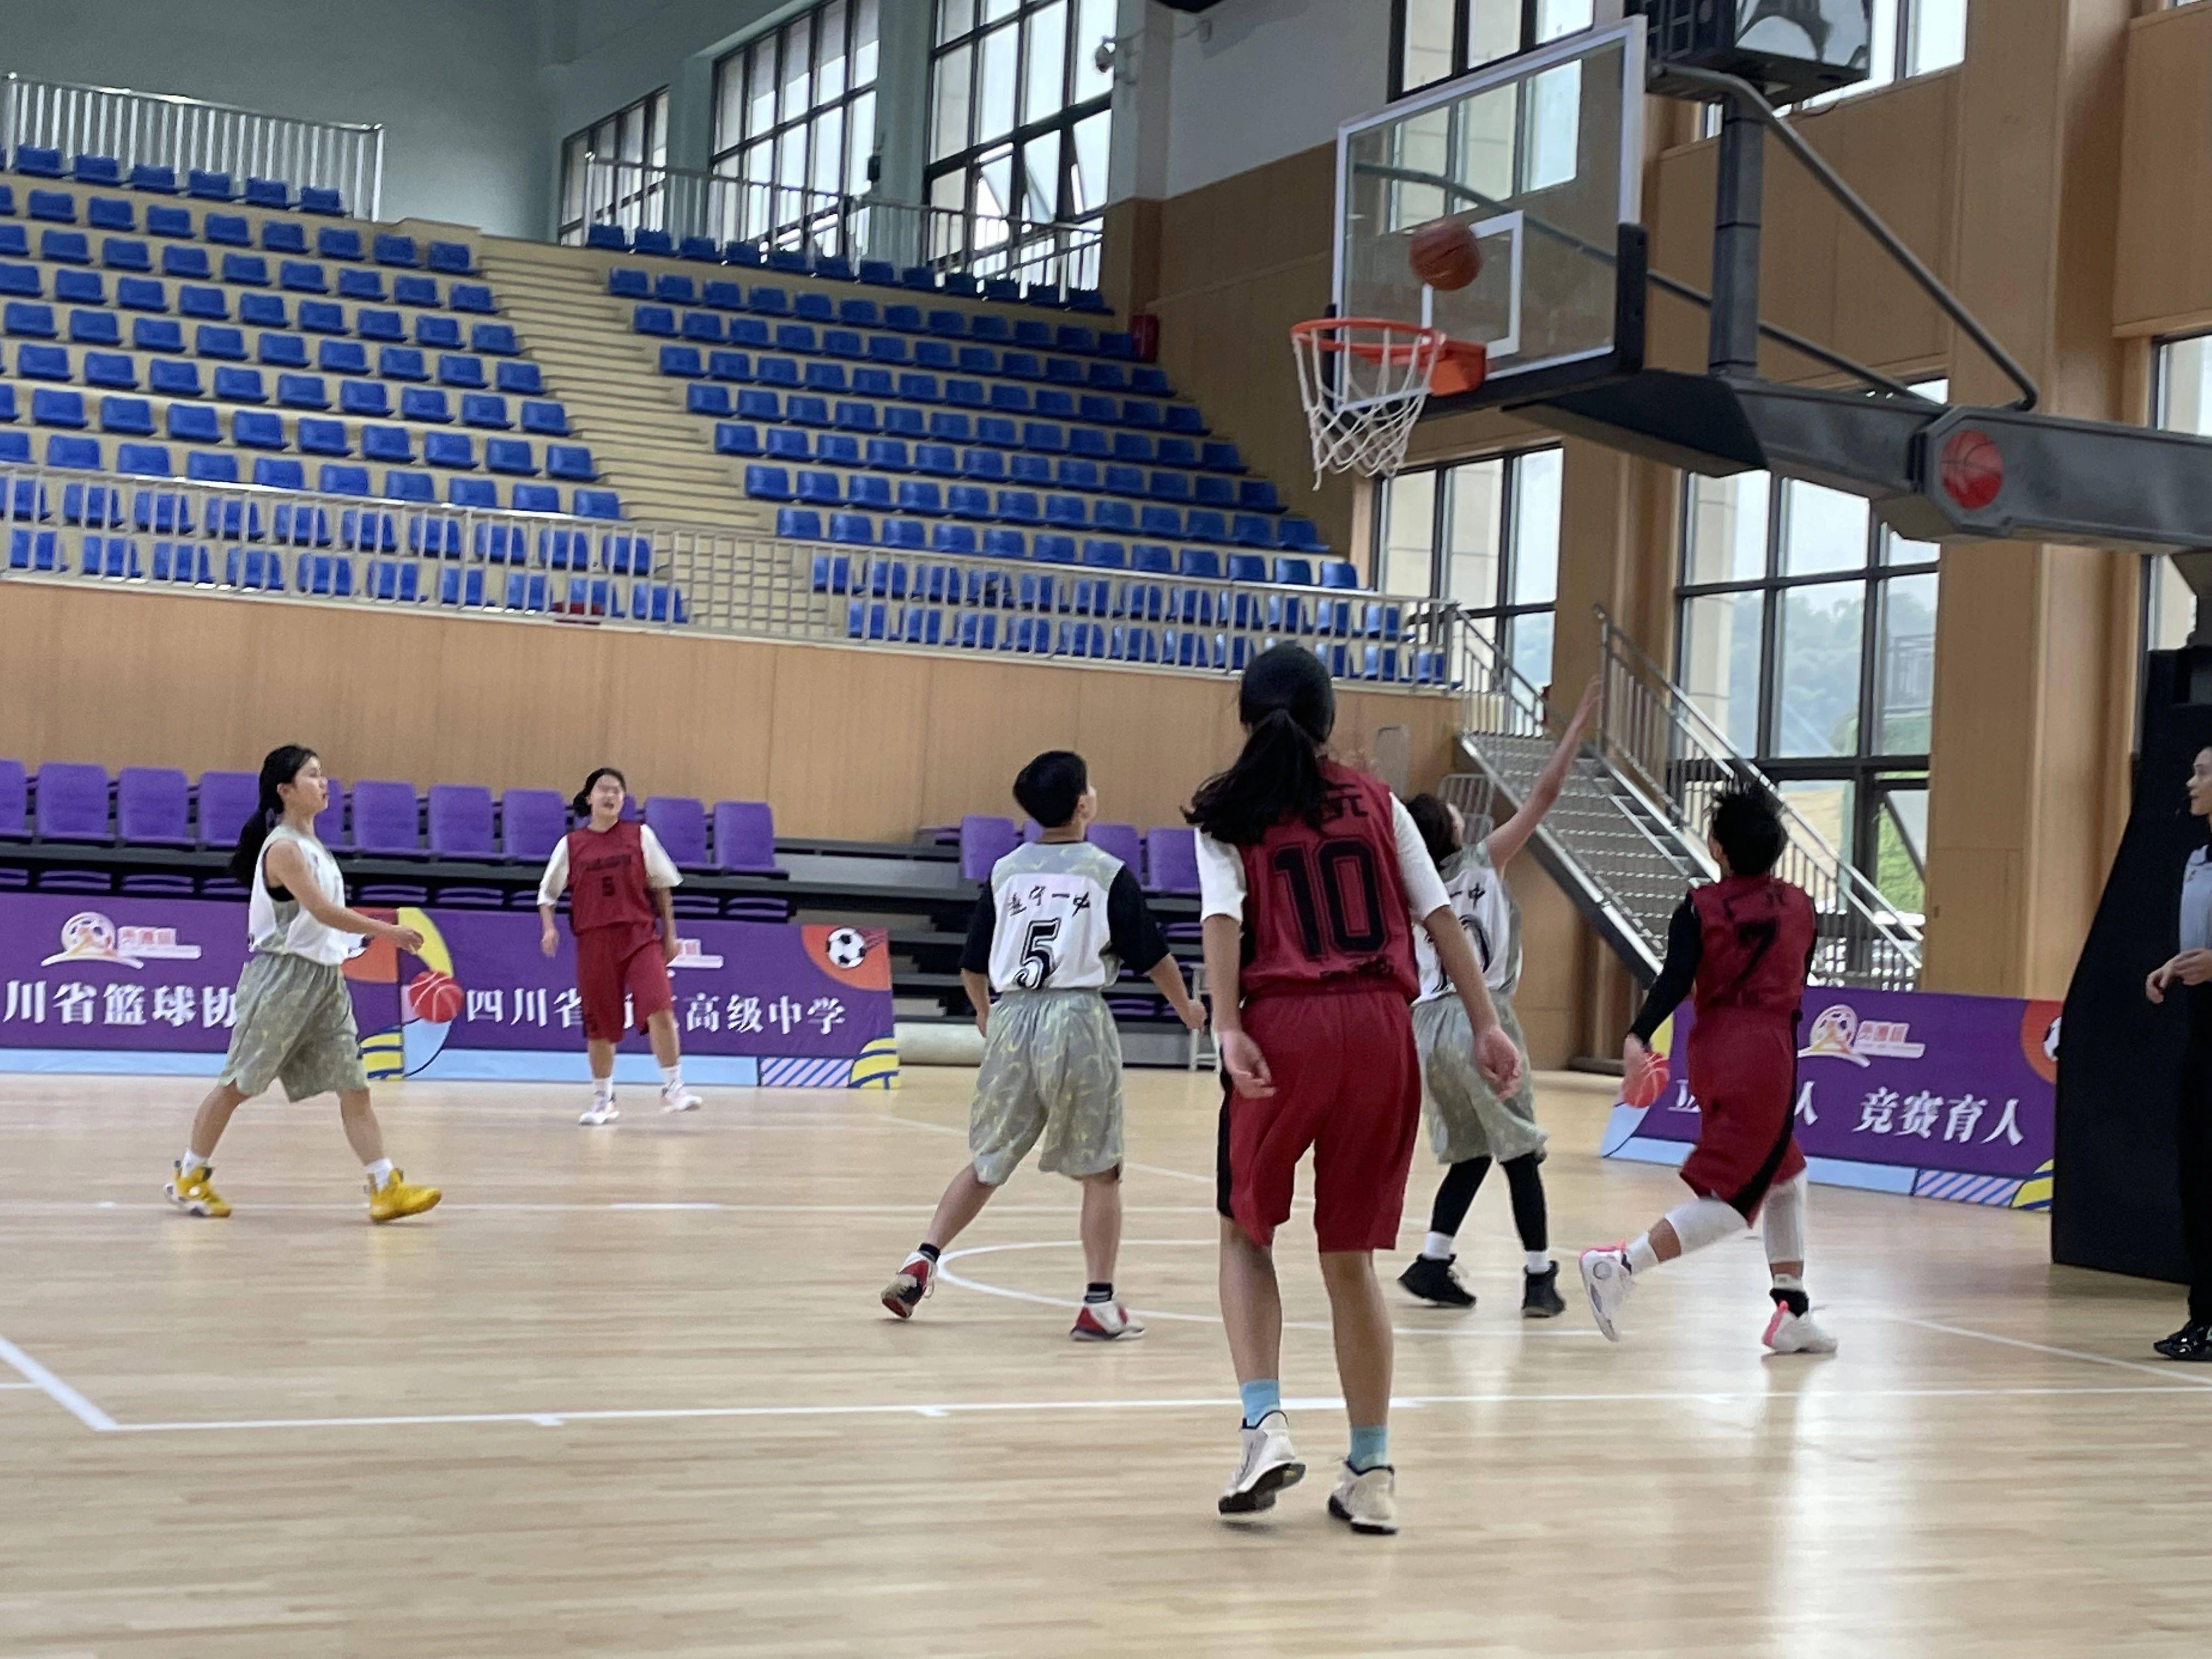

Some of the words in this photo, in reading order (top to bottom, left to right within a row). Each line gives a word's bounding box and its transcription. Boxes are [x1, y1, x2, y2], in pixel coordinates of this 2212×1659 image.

[1270, 837, 1387, 962] 10
[1015, 917, 1062, 989] 5
[1732, 916, 1780, 988] 7
[467, 988, 845, 1035] 四川省高级中学
[1851, 1086, 2024, 1146] 竞赛育人
